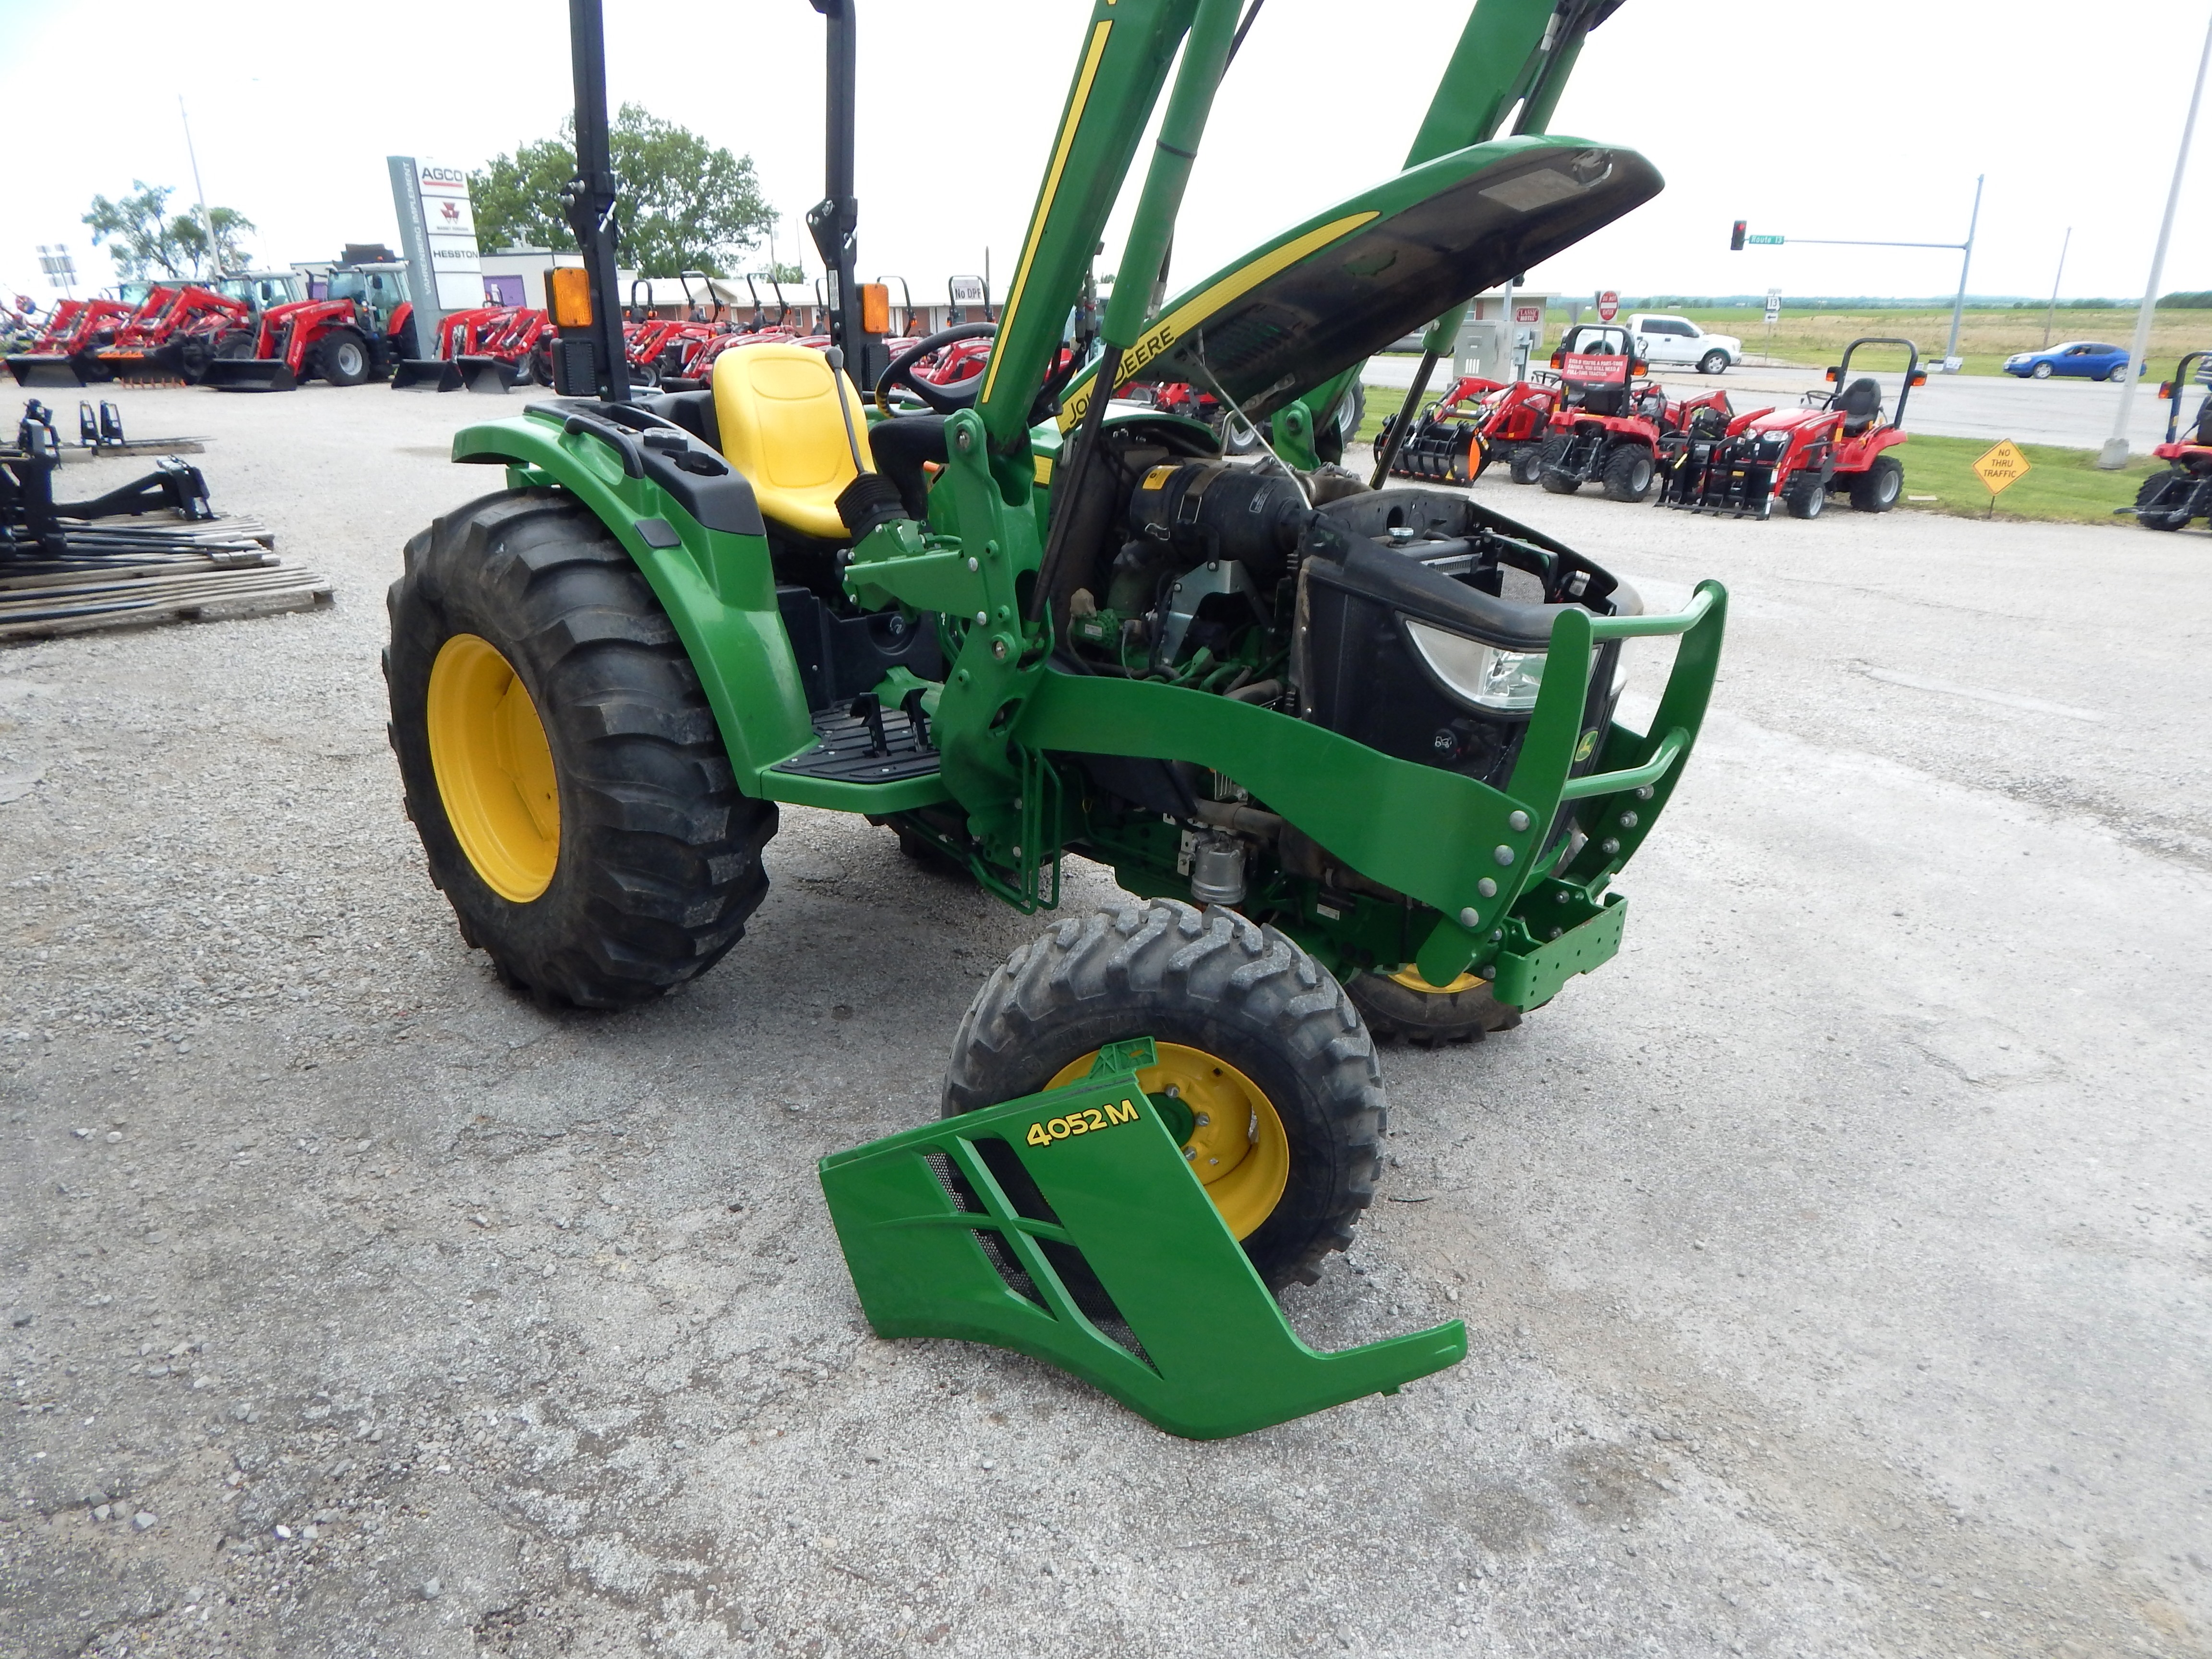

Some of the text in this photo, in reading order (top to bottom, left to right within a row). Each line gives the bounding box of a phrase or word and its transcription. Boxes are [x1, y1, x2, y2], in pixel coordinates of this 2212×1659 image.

[421, 167, 463, 181] AGCO
[403, 161, 419, 223] IMPLEMENT
[1751, 235, 1772, 243] Route
[433, 250, 478, 258] HESSTON
[955, 288, 981, 299] No DPF
[1770, 298, 1778, 307] 13
[1517, 309, 1538, 317] CLASSIC
[1115, 325, 1175, 384] DEERE
[1992, 459, 2014, 468] THRU
[1984, 469, 2017, 478] TRAFFIC
